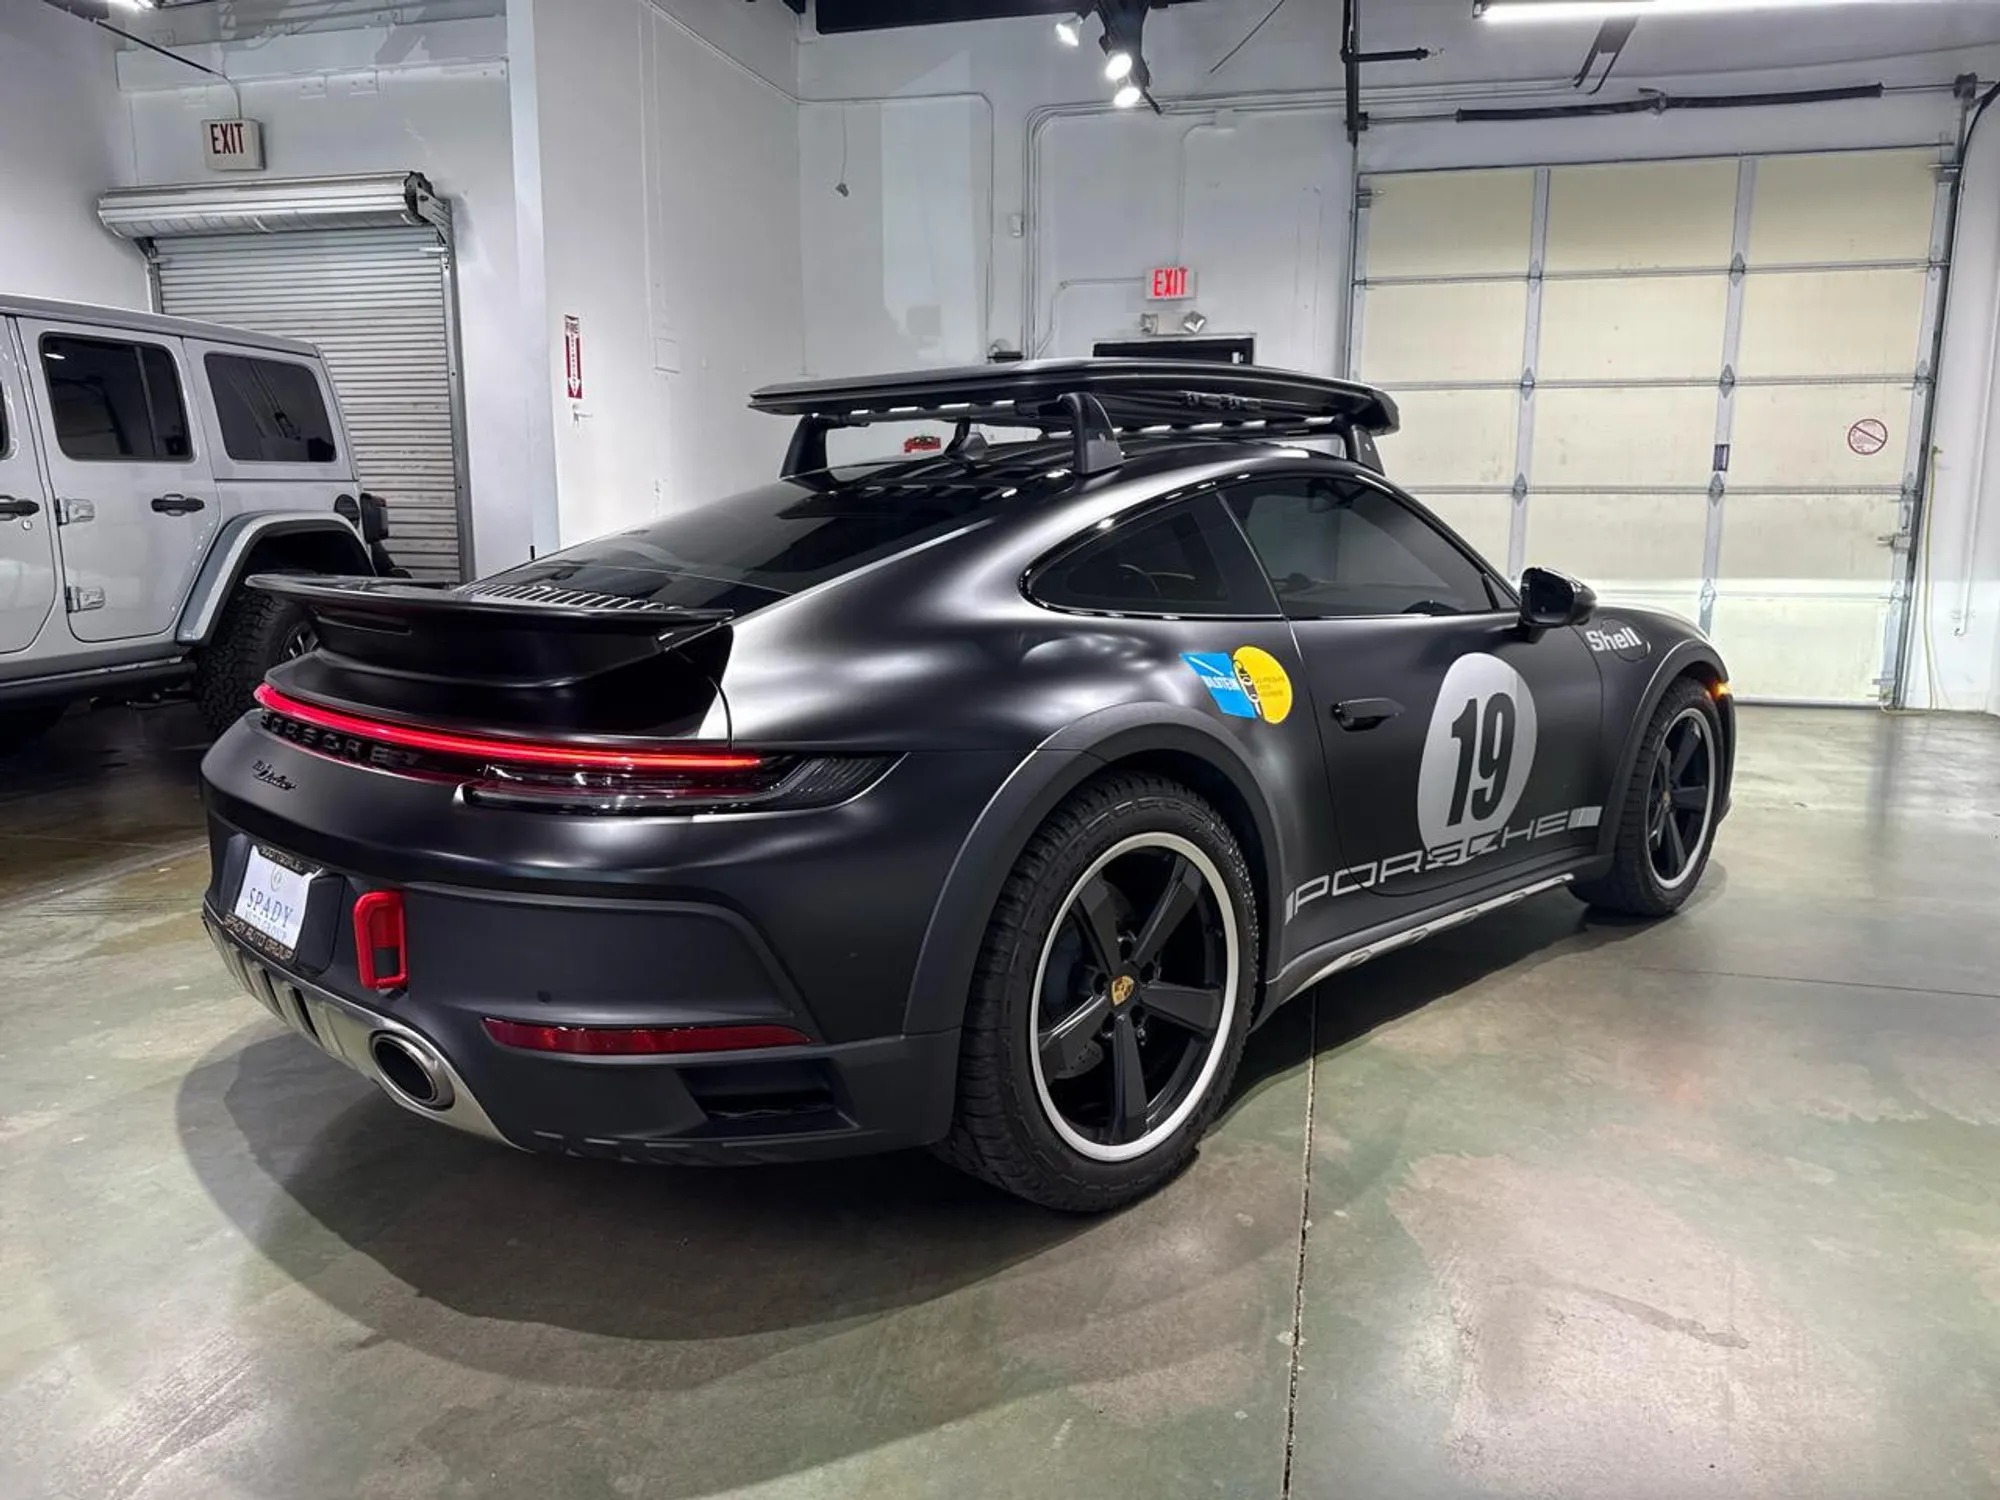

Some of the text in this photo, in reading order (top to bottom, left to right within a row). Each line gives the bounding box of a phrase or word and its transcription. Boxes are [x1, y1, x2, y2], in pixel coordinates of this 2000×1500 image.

[210, 123, 244, 154] EXIT
[1153, 266, 1188, 297] EXIT
[1586, 627, 1642, 652] Shell
[1447, 692, 1516, 828] 19
[1294, 811, 1570, 915] PORSCHE
[247, 888, 294, 928] SPADY
